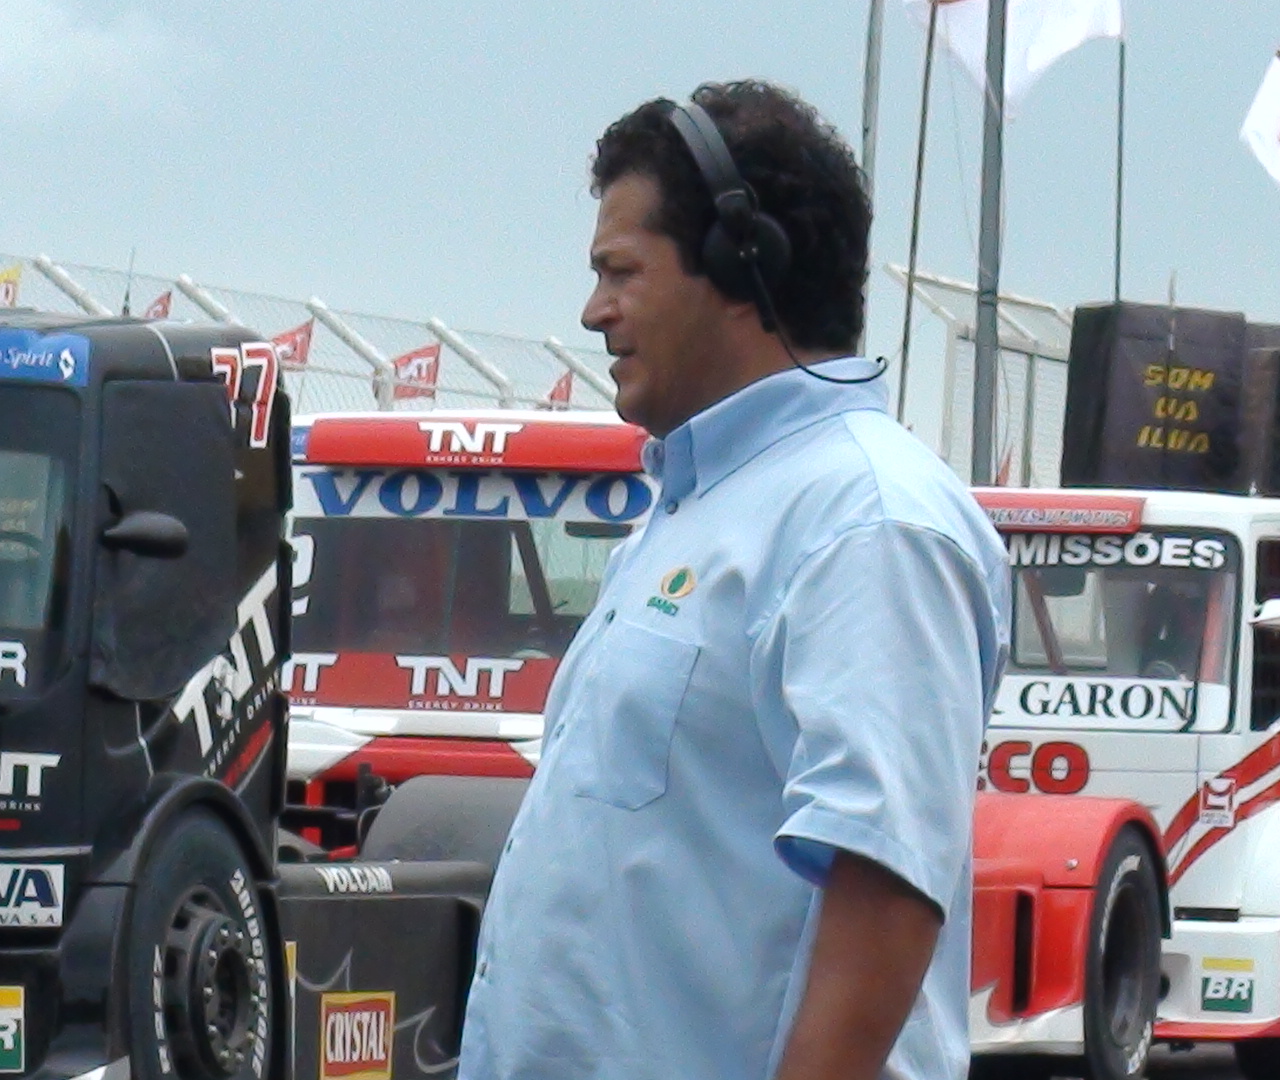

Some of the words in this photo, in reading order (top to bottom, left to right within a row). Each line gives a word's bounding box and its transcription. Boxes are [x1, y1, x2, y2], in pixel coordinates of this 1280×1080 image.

[4, 347, 53, 369] Spirit
[210, 341, 280, 448] 77
[418, 421, 524, 454] TNT
[301, 470, 653, 522] VOLVO
[1009, 533, 1226, 568] MISSÕES
[172, 560, 278, 759] TNT
[395, 655, 526, 698] TNT
[408, 699, 459, 710] ENERGY
[463, 701, 504, 711] DRINK
[1020, 680, 1193, 722] GARON
[979, 740, 1090, 795] CO
[0, 800, 41, 811] DRINK
[315, 866, 394, 893] VOLCAM
[1204, 976, 1251, 1000] BR
[326, 1011, 386, 1064] CRYSTAL
